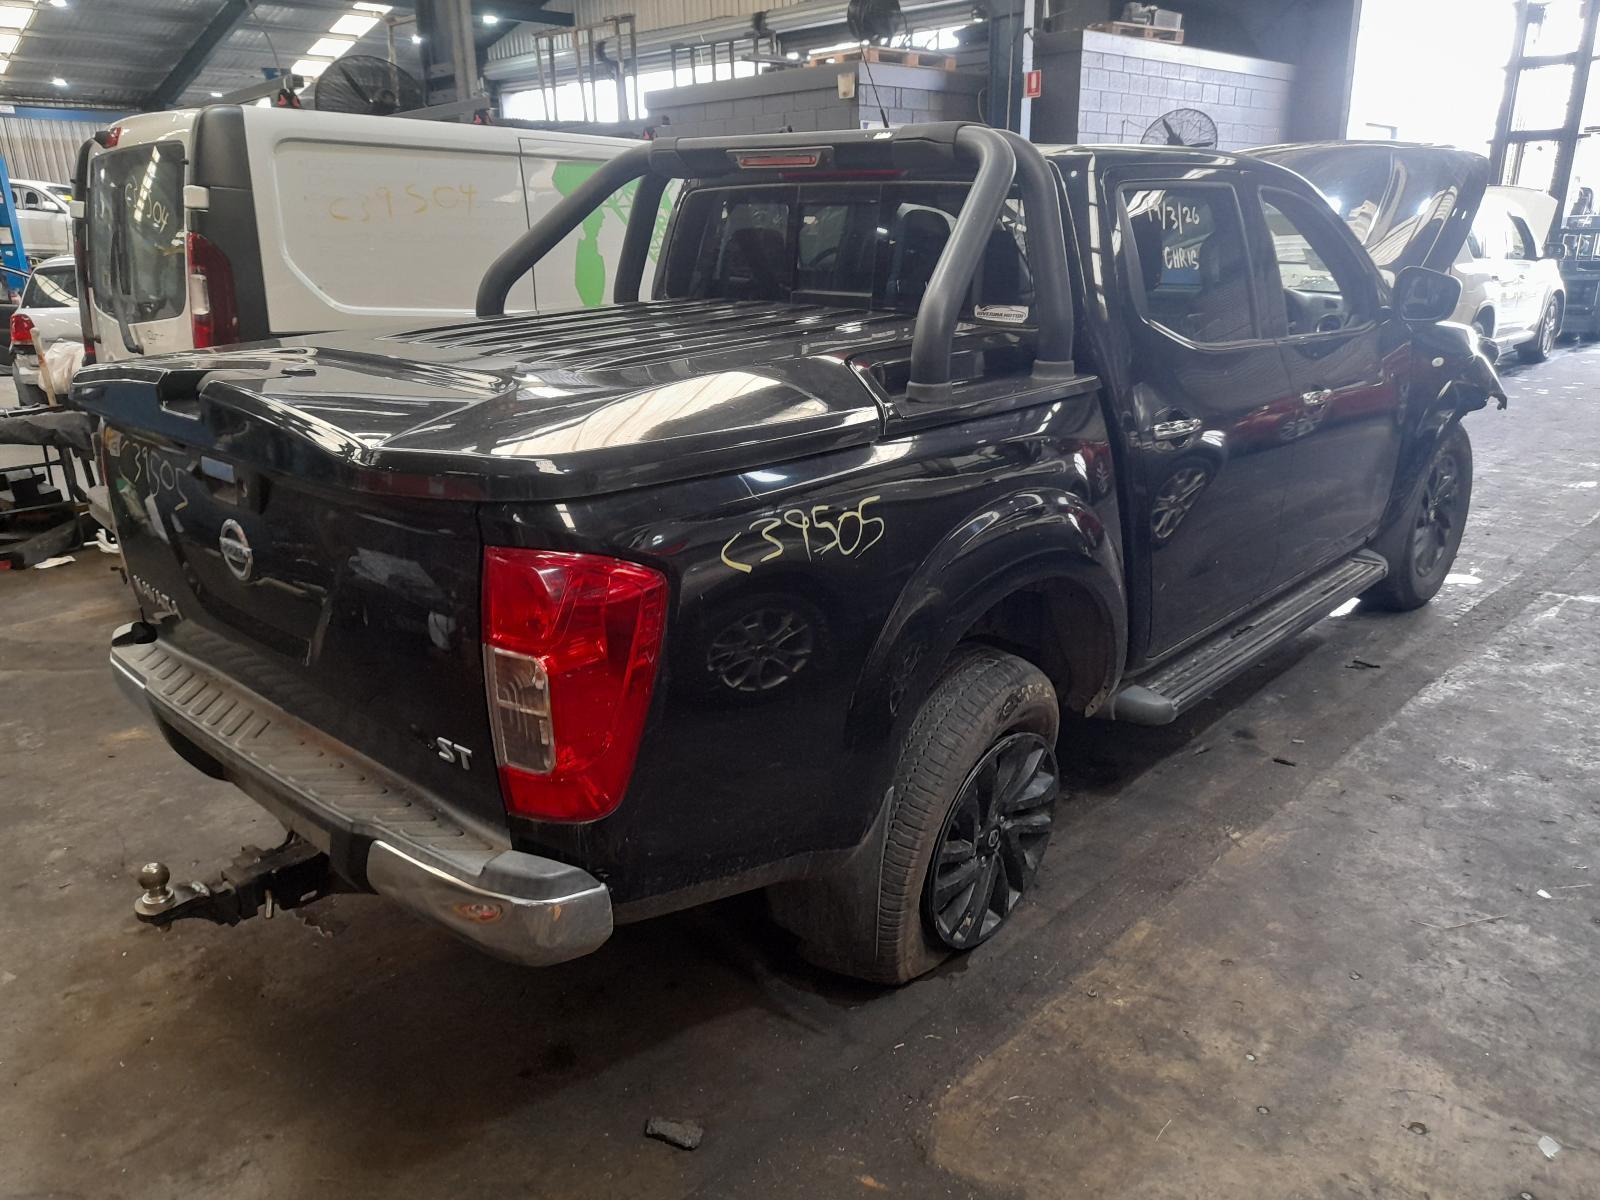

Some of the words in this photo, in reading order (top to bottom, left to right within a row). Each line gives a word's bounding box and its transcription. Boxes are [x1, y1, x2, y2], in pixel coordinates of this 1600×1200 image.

[1163, 246, 1200, 270] CHRIS
[720, 495, 886, 574] C39505
[436, 736, 473, 770] ST
